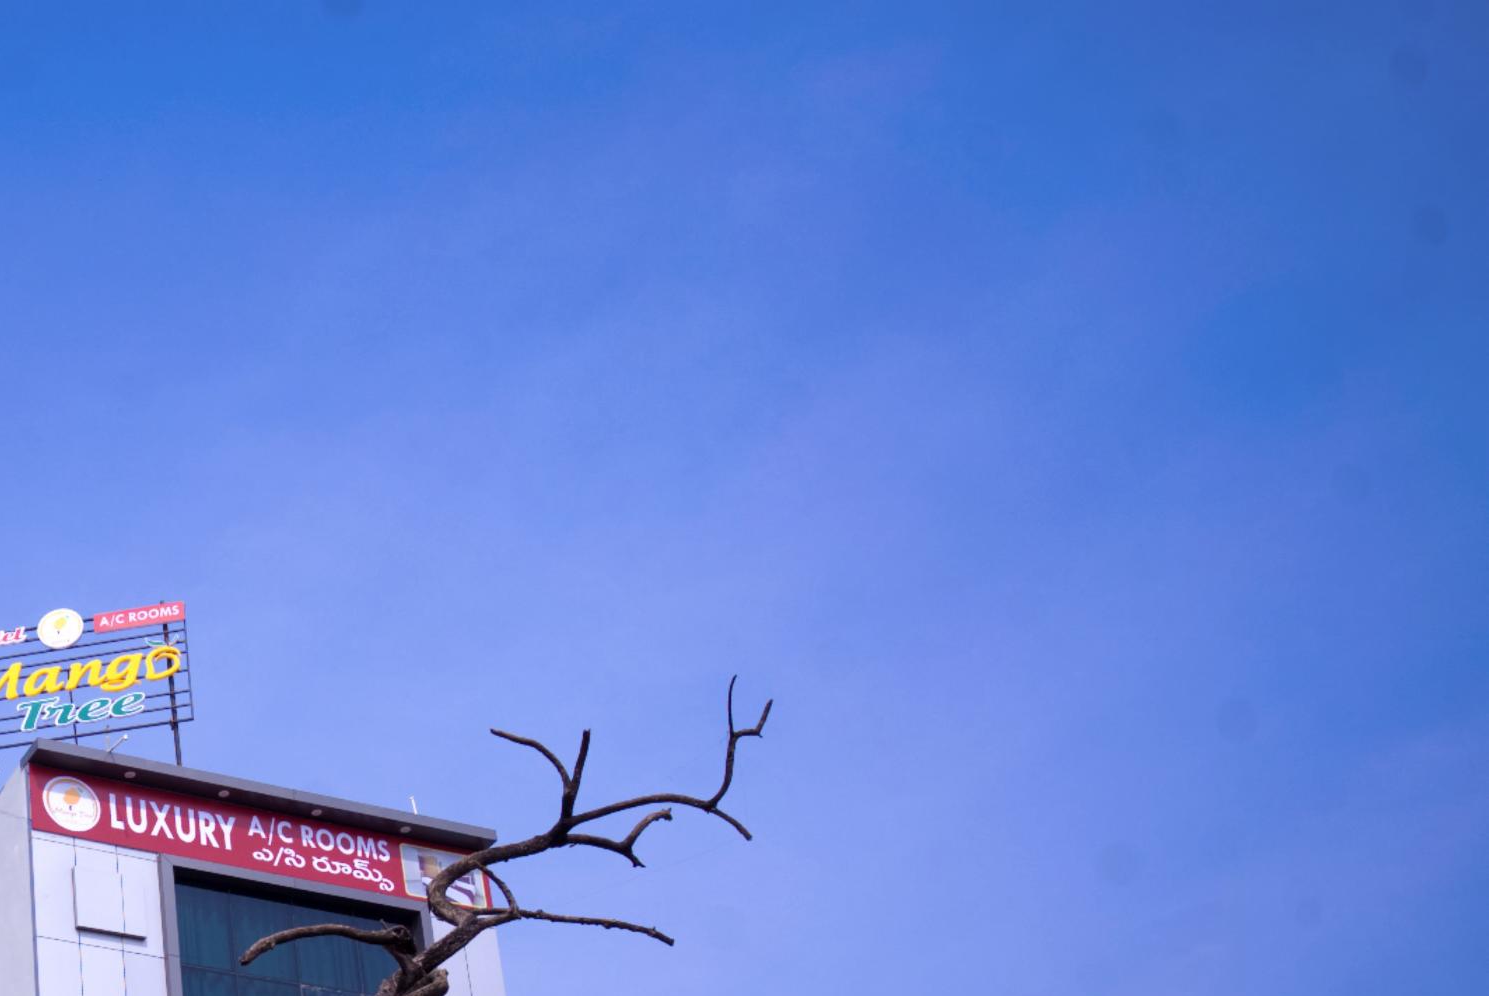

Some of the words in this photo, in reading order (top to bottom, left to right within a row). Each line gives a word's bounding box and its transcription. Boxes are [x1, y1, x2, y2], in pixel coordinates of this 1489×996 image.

[99, 613, 126, 628] A/C
[128, 604, 181, 622] ROOMS
[17, 691, 146, 732] Tree
[109, 793, 237, 851] LUXURY
[247, 815, 293, 847] A/C
[300, 824, 391, 862] ROOMS
